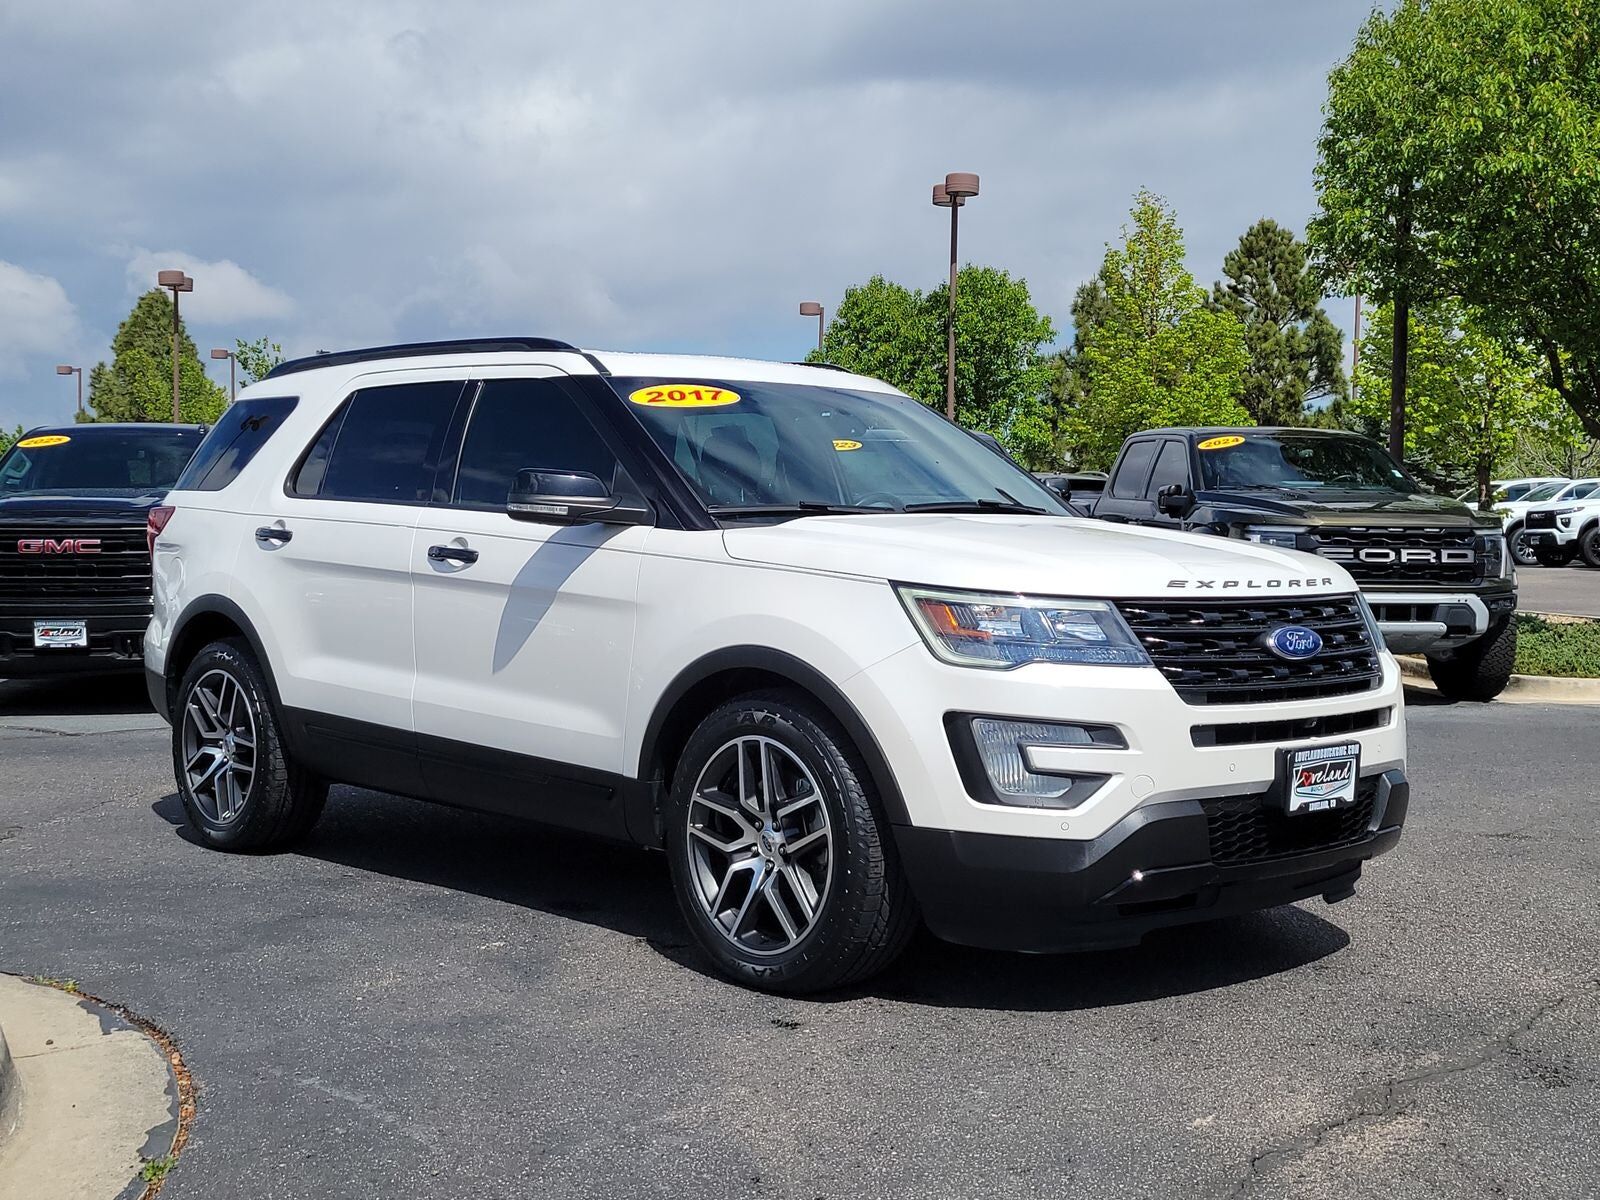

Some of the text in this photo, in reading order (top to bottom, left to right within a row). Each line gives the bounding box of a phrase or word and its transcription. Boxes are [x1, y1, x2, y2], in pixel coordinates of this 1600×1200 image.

[646, 390, 722, 403] 2017
[1204, 437, 1239, 447] 2024
[18, 539, 101, 554] GMC
[1316, 547, 1475, 563] FORD
[1166, 578, 1333, 589] EXPLORER
[1286, 631, 1314, 650] Ford
